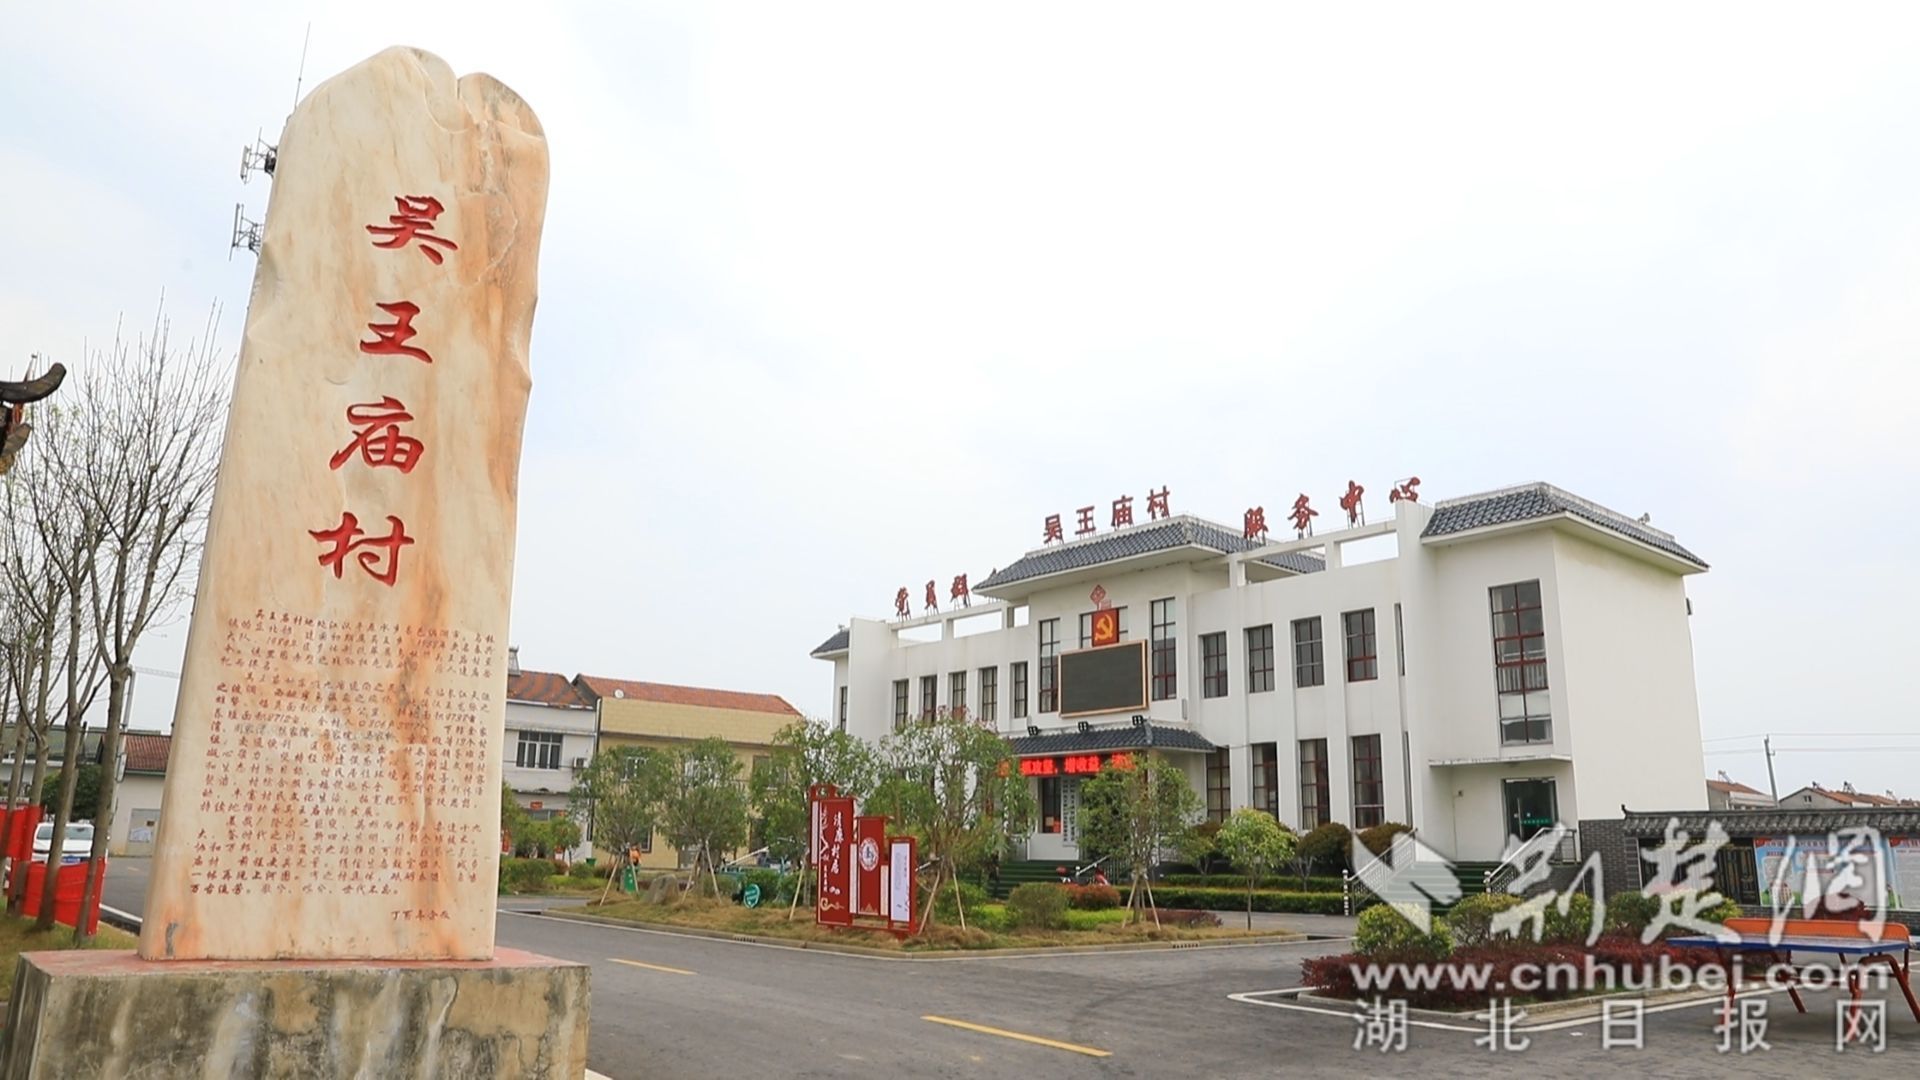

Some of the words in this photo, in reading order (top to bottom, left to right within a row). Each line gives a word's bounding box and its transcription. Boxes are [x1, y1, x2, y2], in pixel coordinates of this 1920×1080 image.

[308, 195, 458, 587] 吴王庙村
[1043, 485, 1170, 544] 吴王庙村
[1243, 476, 1421, 540] 服务中心
[895, 567, 997, 617] 党员群
